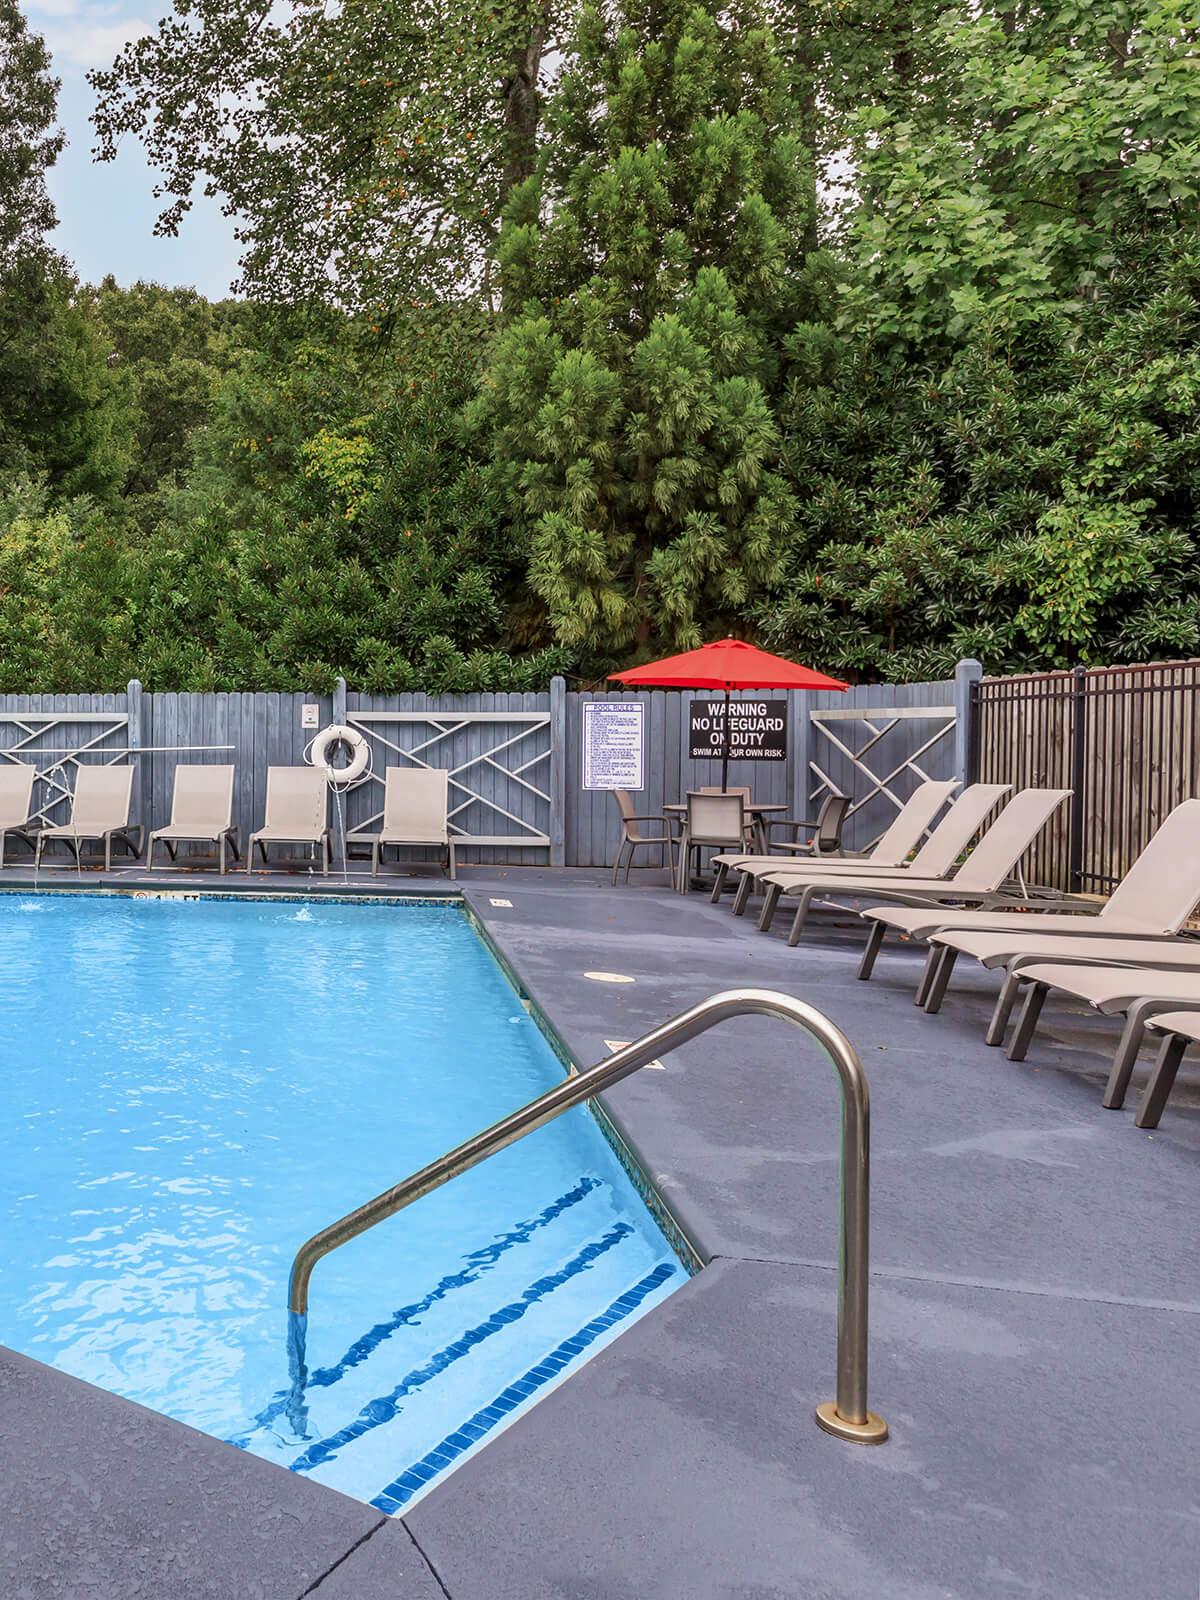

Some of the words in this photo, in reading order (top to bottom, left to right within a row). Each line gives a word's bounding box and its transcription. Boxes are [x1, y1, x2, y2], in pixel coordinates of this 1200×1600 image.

[708, 704, 767, 716] WARNING
[692, 718, 710, 730] NO
[713, 718, 784, 730] LIEGUARD
[731, 732, 764, 745] DUTY
[693, 748, 712, 756] SWIM
[745, 749, 763, 757] OWN
[764, 749, 782, 757] RISK
